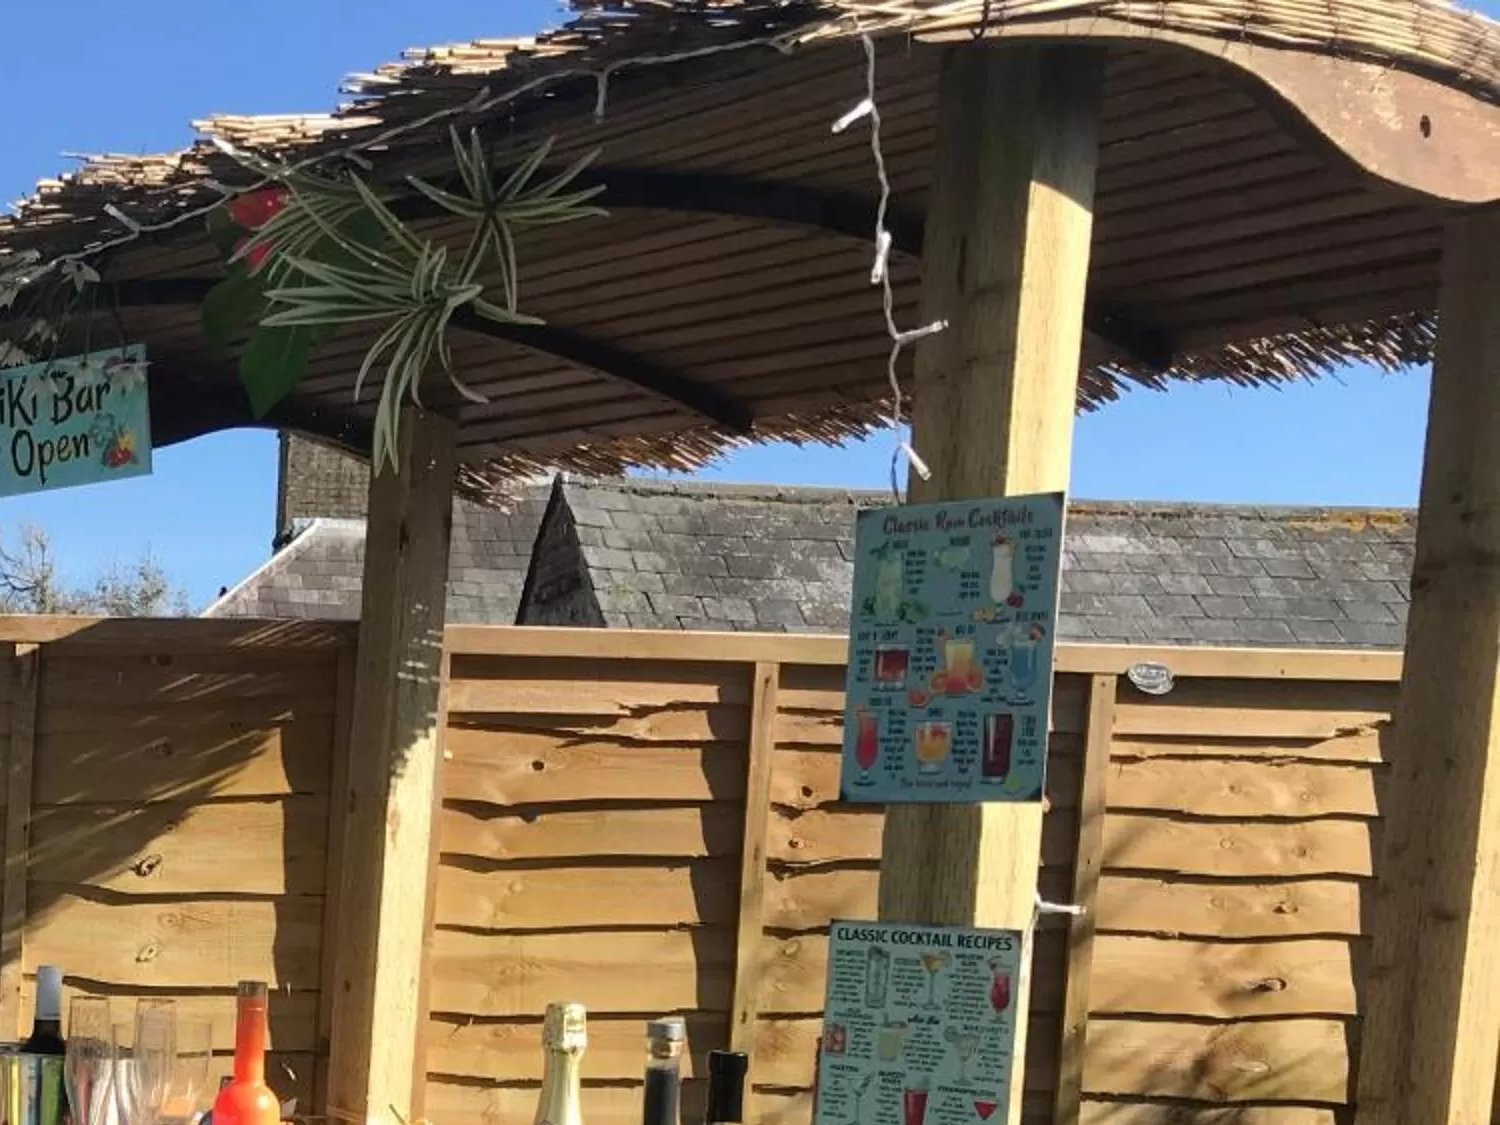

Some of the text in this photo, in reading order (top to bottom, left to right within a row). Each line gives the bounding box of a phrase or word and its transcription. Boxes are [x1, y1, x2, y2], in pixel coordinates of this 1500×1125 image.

[50, 371, 111, 425] Bar
[11, 427, 90, 487] Open
[837, 927, 1013, 951] CLASSIC COCKTAIL RECIPES
